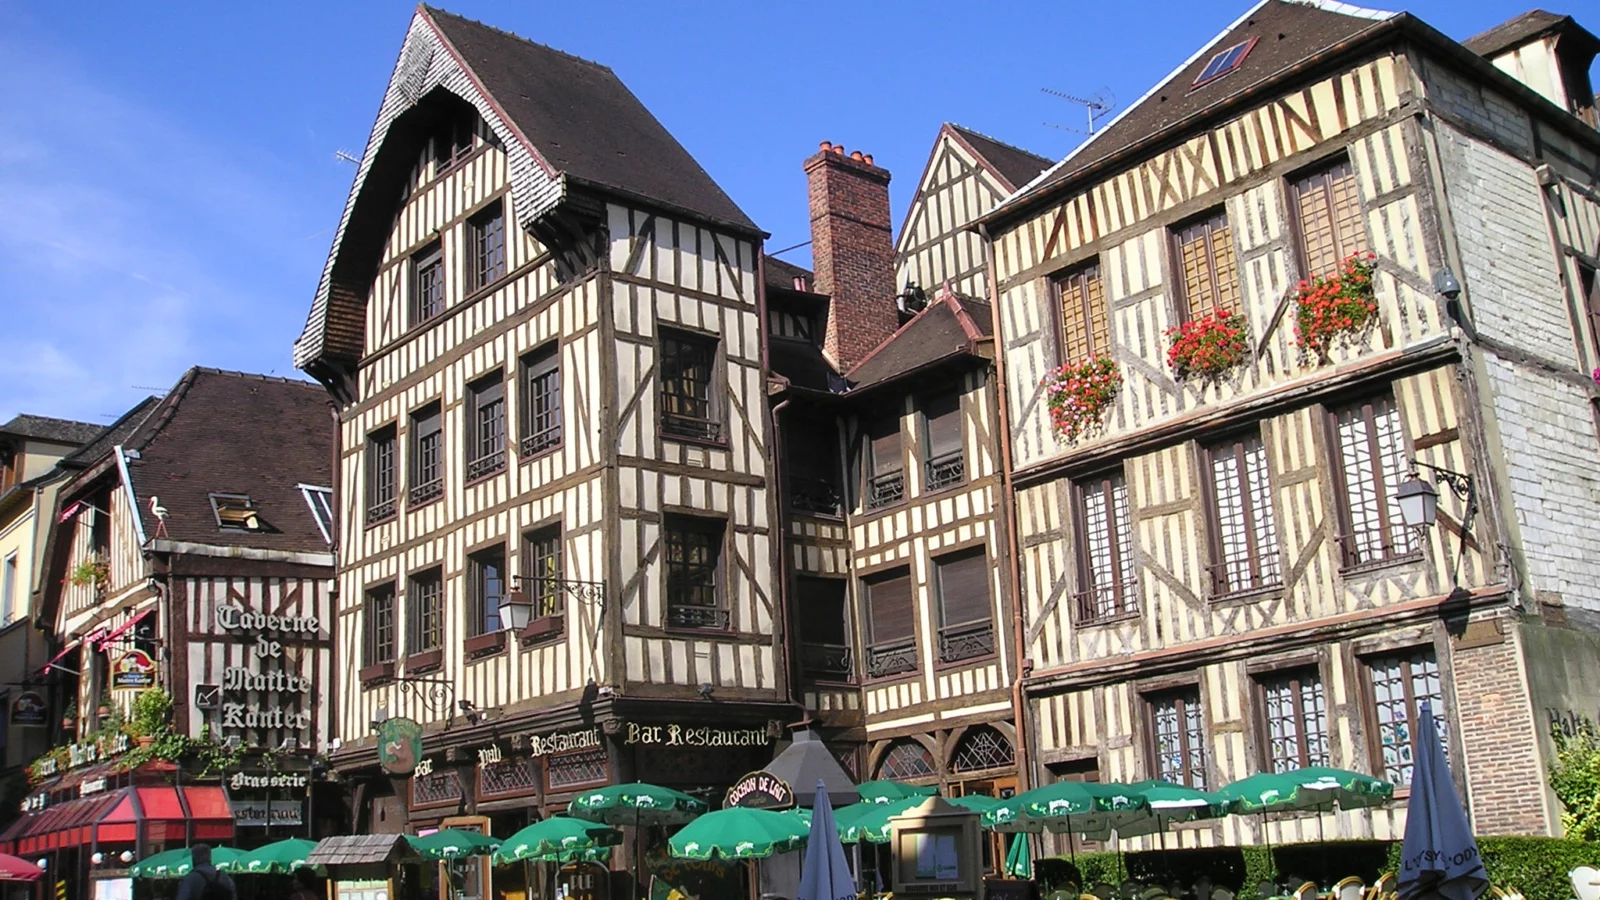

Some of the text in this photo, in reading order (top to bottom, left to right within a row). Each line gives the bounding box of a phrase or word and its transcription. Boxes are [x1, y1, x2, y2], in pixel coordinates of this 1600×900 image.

[217, 604, 319, 633] Taverne
[256, 634, 282, 658] de
[222, 701, 308, 730] Kanter
[530, 726, 601, 758] Restaurant
[625, 722, 769, 746] Bar Restaurant
[230, 772, 306, 790] Brasserie
[729, 777, 757, 806] COCHON
[759, 776, 769, 792] DE
[769, 780, 787, 802] LAIT
[570, 873, 595, 891] PUB
